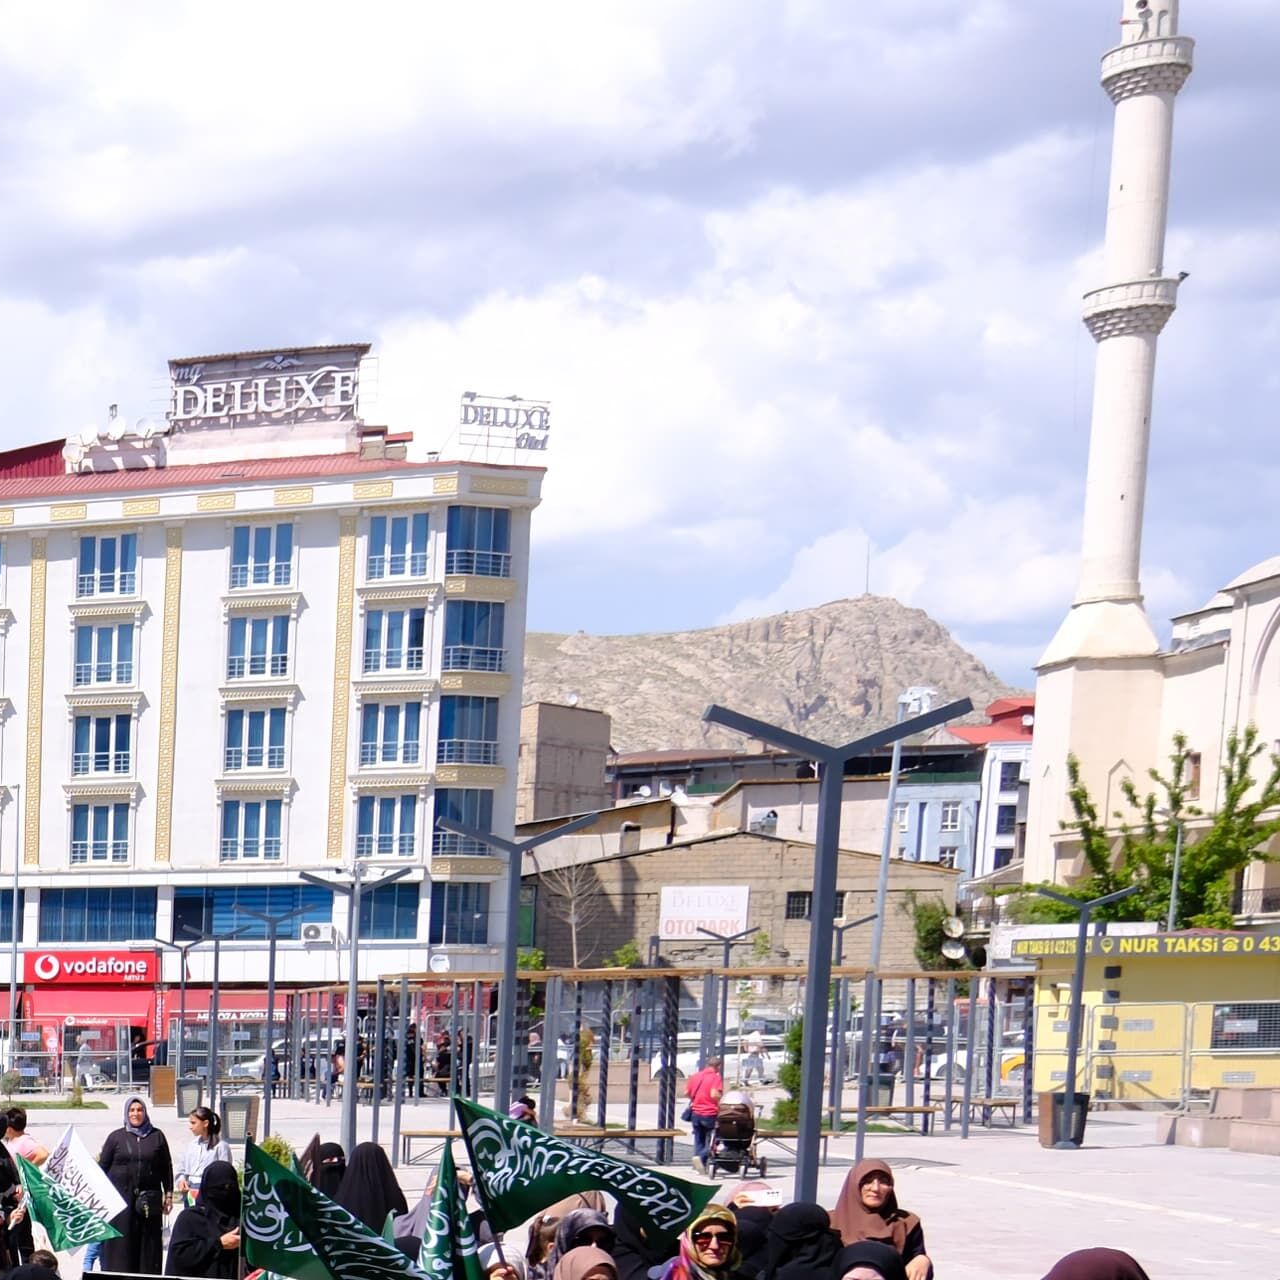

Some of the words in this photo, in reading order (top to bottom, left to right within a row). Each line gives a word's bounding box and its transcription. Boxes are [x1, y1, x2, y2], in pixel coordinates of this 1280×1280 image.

[170, 367, 358, 421] DELUXE
[461, 404, 550, 431] DELUXE
[1120, 938, 1158, 952] NUR
[1243, 937, 1254, 951] 0
[63, 952, 147, 975] vodafone
